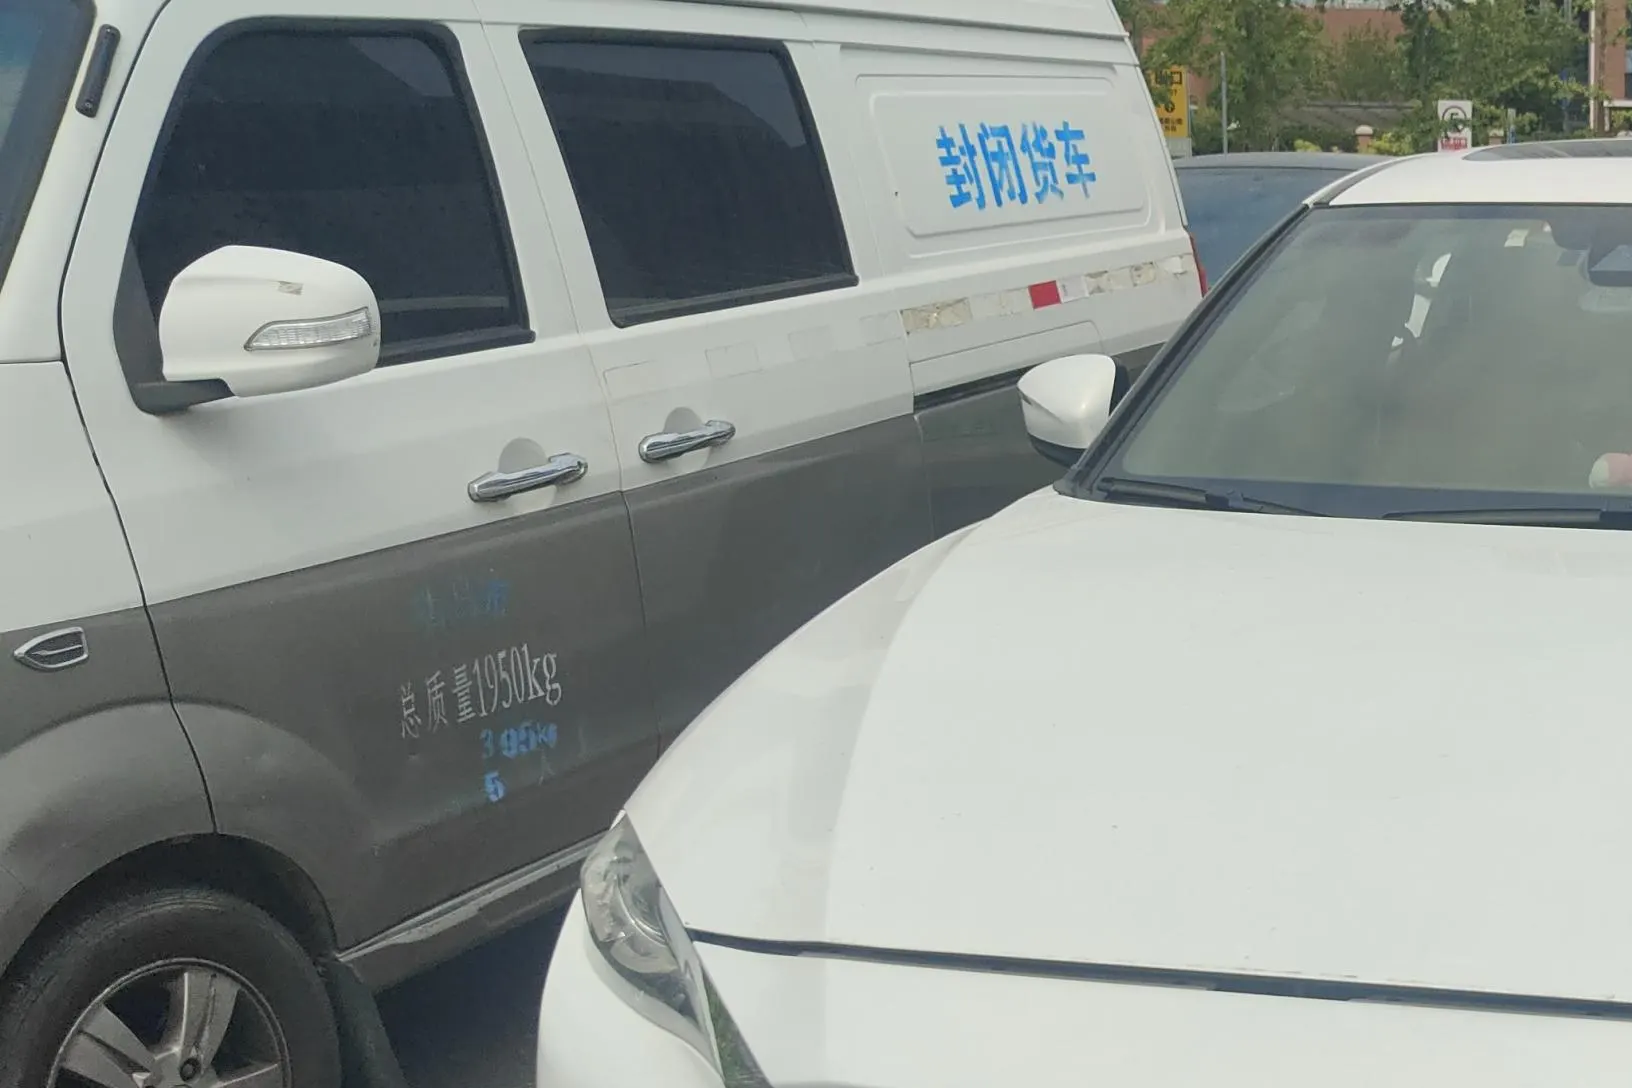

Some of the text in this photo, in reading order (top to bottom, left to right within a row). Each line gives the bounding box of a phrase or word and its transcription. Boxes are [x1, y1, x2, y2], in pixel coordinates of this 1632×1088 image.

[936, 120, 1097, 210] 封闭货车
[400, 643, 562, 739] 总质量1950kg
